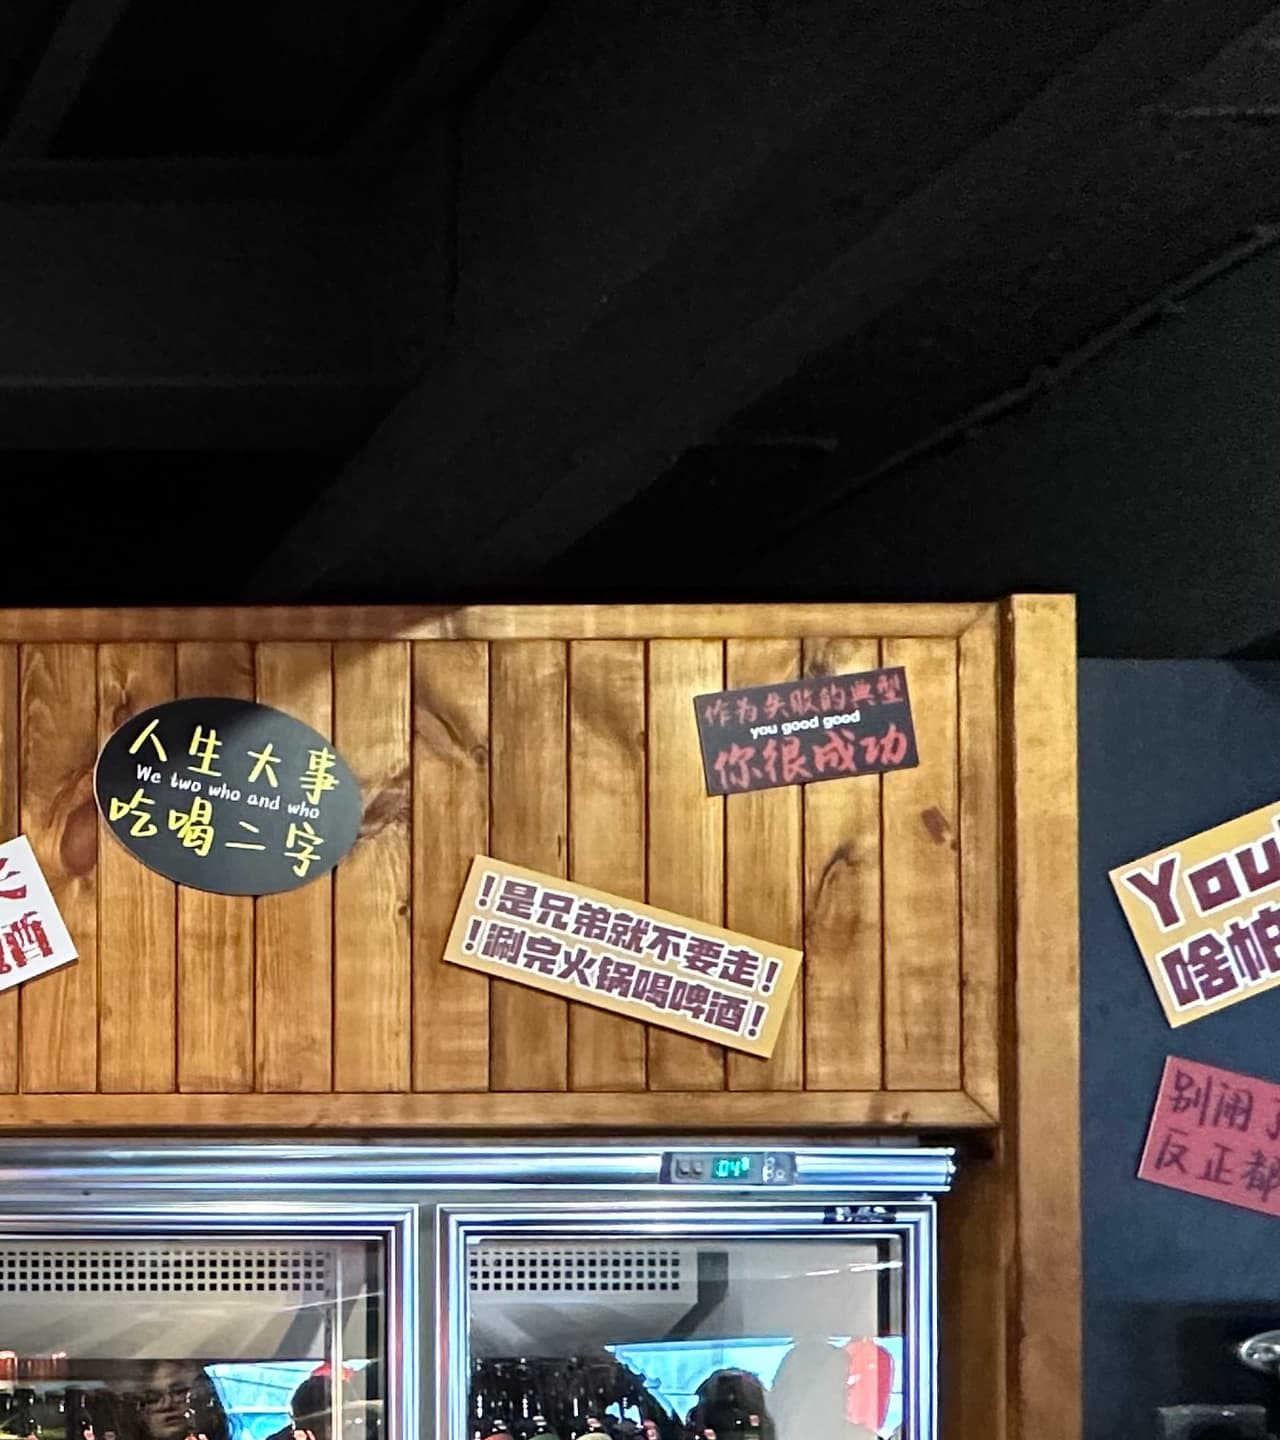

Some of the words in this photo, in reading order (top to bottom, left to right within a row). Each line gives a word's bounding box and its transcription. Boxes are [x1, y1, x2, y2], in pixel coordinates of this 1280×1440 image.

[704, 674, 905, 727] 作为失败的典型
[750, 722, 778, 740] you
[781, 715, 820, 736] good
[822, 709, 861, 730] good
[128, 718, 340, 806] 人生大事
[712, 722, 908, 791] 你很成功
[136, 763, 162, 785] We
[170, 772, 202, 793] two
[208, 783, 241, 802] who
[247, 793, 281, 812] and
[287, 801, 320, 820] who
[108, 788, 324, 878] 吃喝二字
[1125, 819, 1280, 928] You
